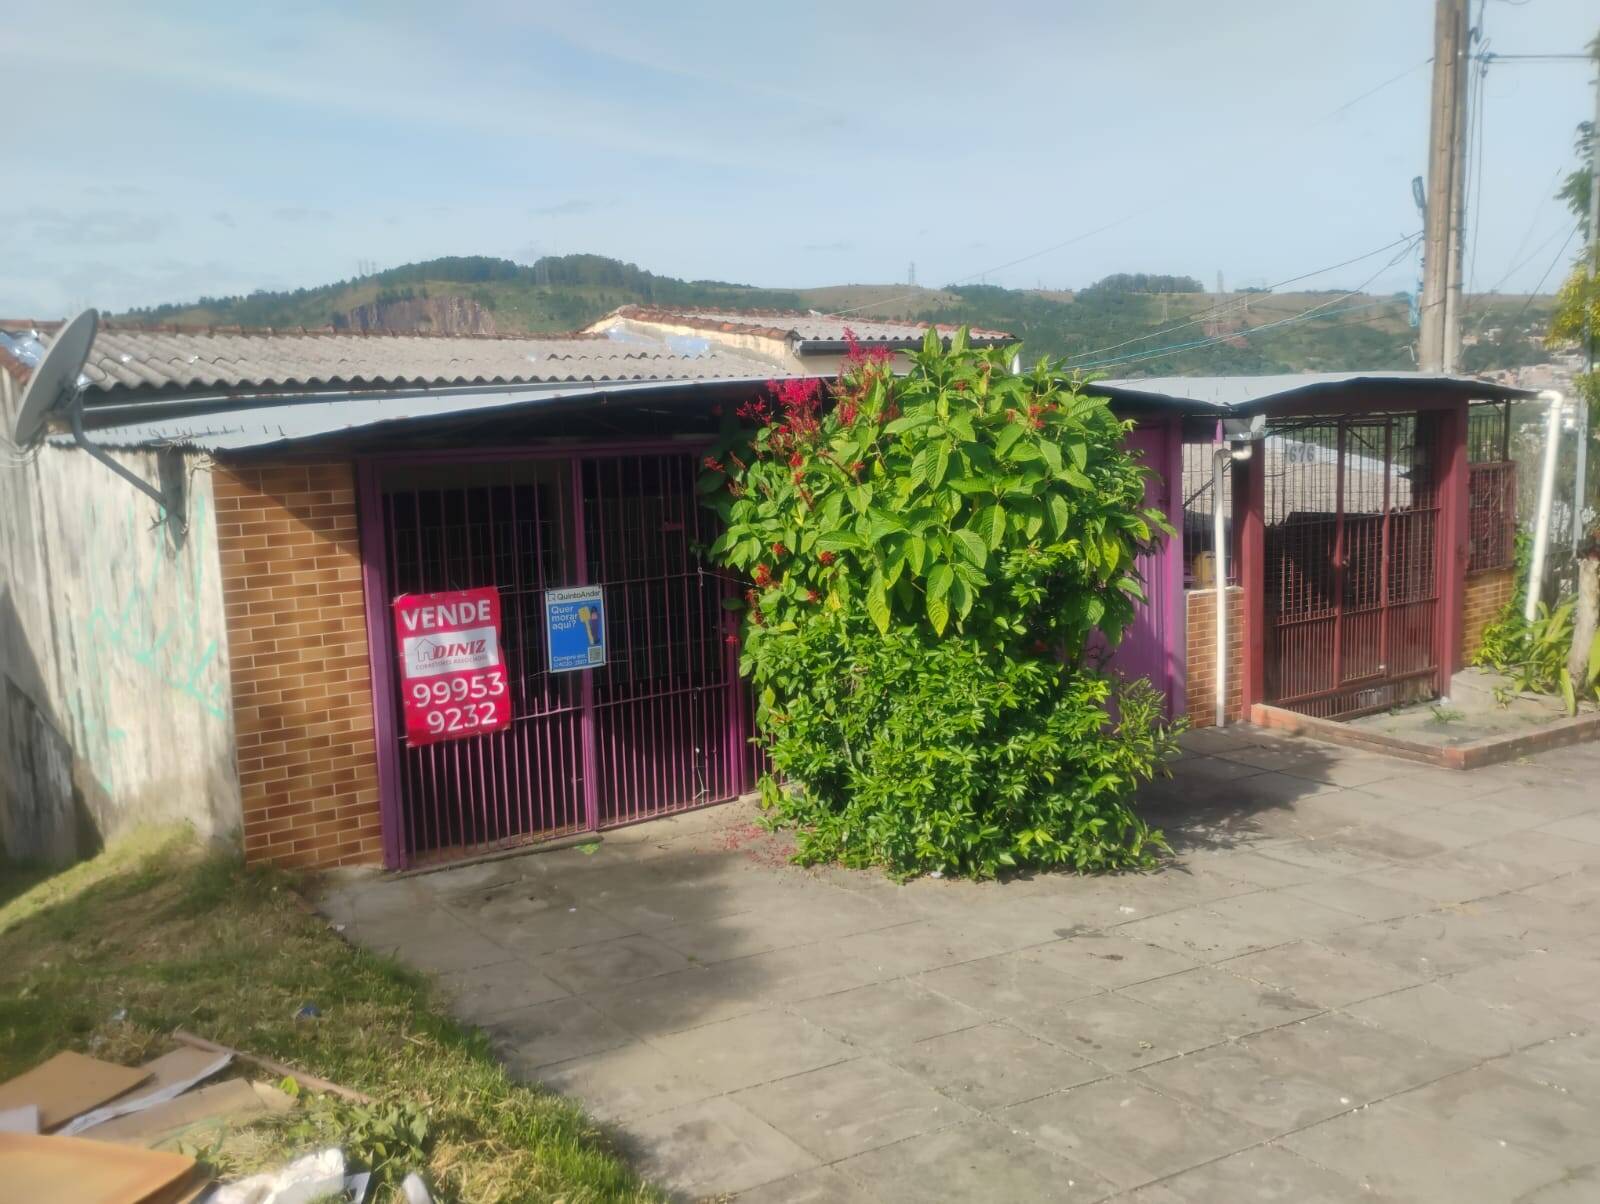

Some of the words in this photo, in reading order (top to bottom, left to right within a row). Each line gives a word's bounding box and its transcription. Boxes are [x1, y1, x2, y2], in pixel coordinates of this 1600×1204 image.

[402, 599, 491, 631] VENDE
[551, 606, 573, 614] Quer
[551, 613, 577, 622] morar
[552, 620, 576, 630] aqui?
[433, 638, 487, 660] DINIZ
[413, 672, 504, 708] 99953
[427, 701, 498, 734] 9232
